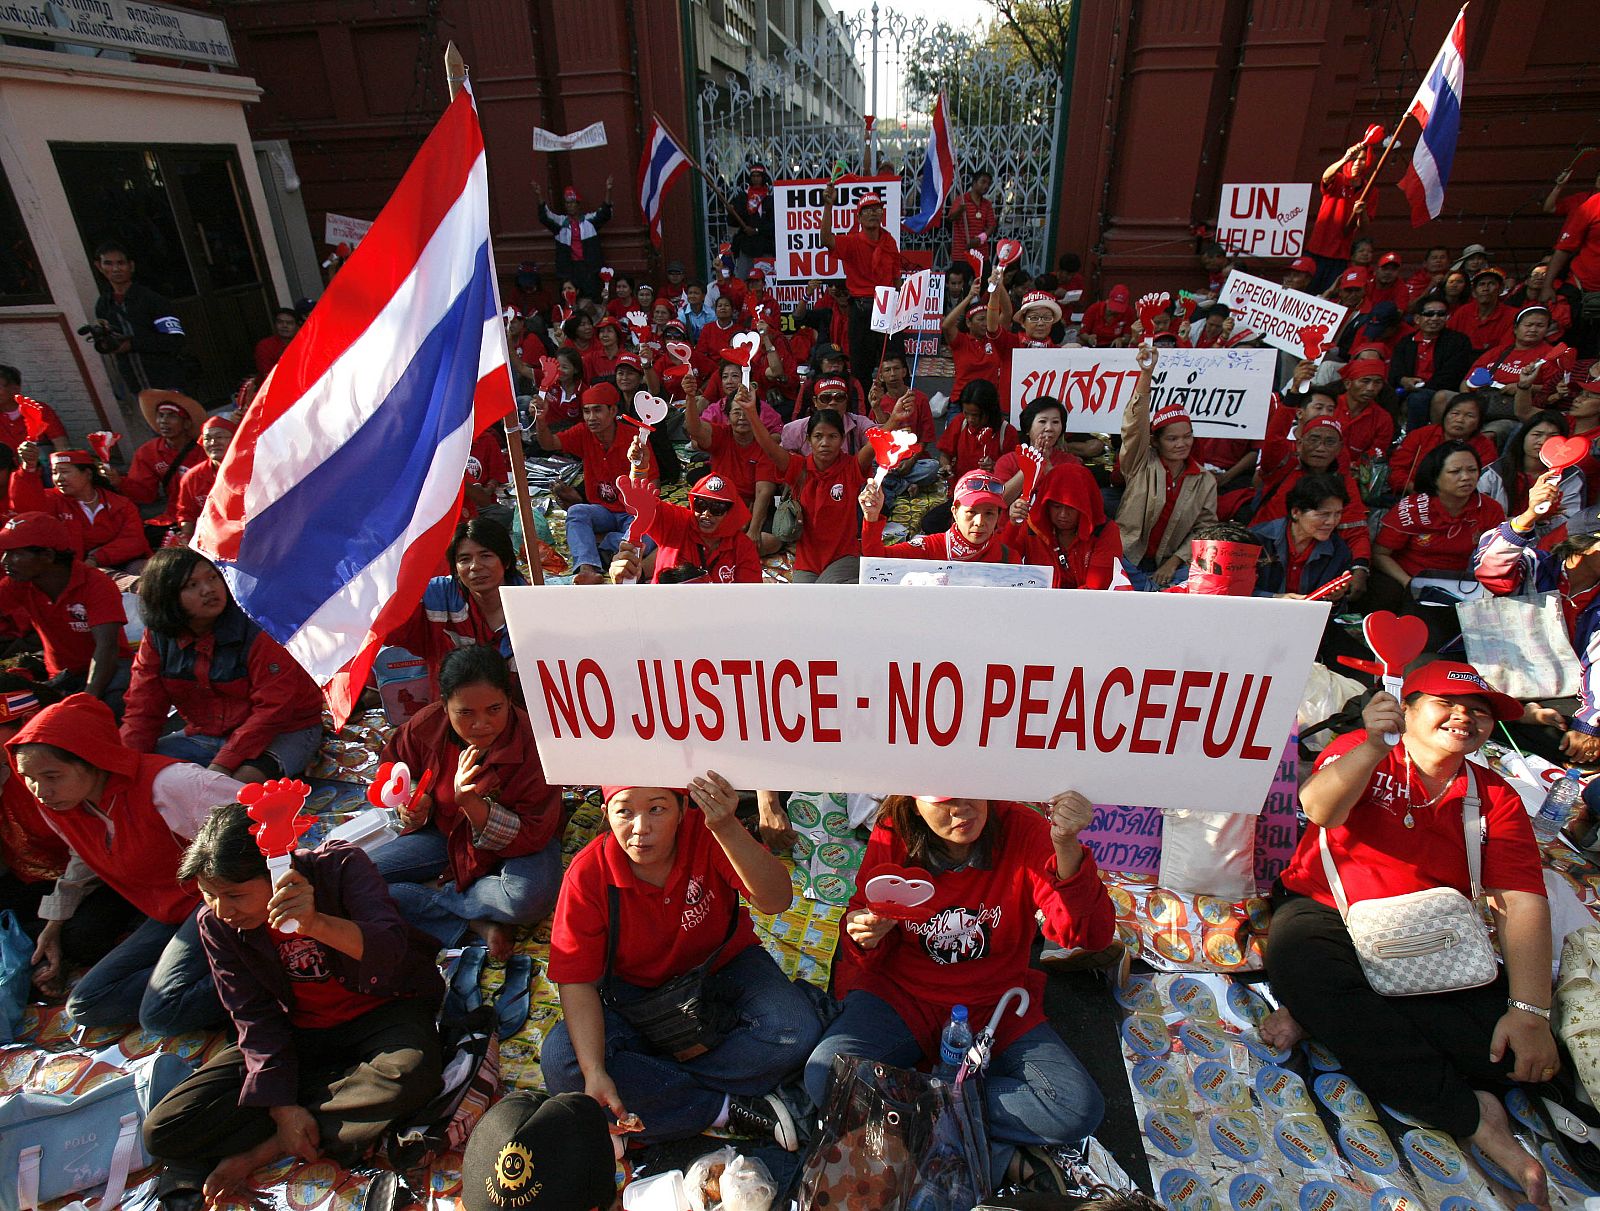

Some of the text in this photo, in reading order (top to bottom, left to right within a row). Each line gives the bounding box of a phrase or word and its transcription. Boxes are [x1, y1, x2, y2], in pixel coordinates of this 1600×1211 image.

[1230, 187, 1280, 219] UN
[787, 233, 804, 250] IS
[1216, 227, 1303, 257] HELP US
[789, 250, 847, 277] NO
[1230, 278, 1339, 326] FOREIGN MINISTER
[1247, 308, 1304, 346] TERRORIS
[536, 657, 616, 740] NO
[631, 658, 842, 743] JUSTICE
[888, 661, 964, 747] NO
[978, 663, 1273, 761] PEACEFUL
[681, 904, 711, 932] TODAY
[64, 1132, 97, 1149] POLO
[485, 1176, 544, 1208] SUNNY TOURS
